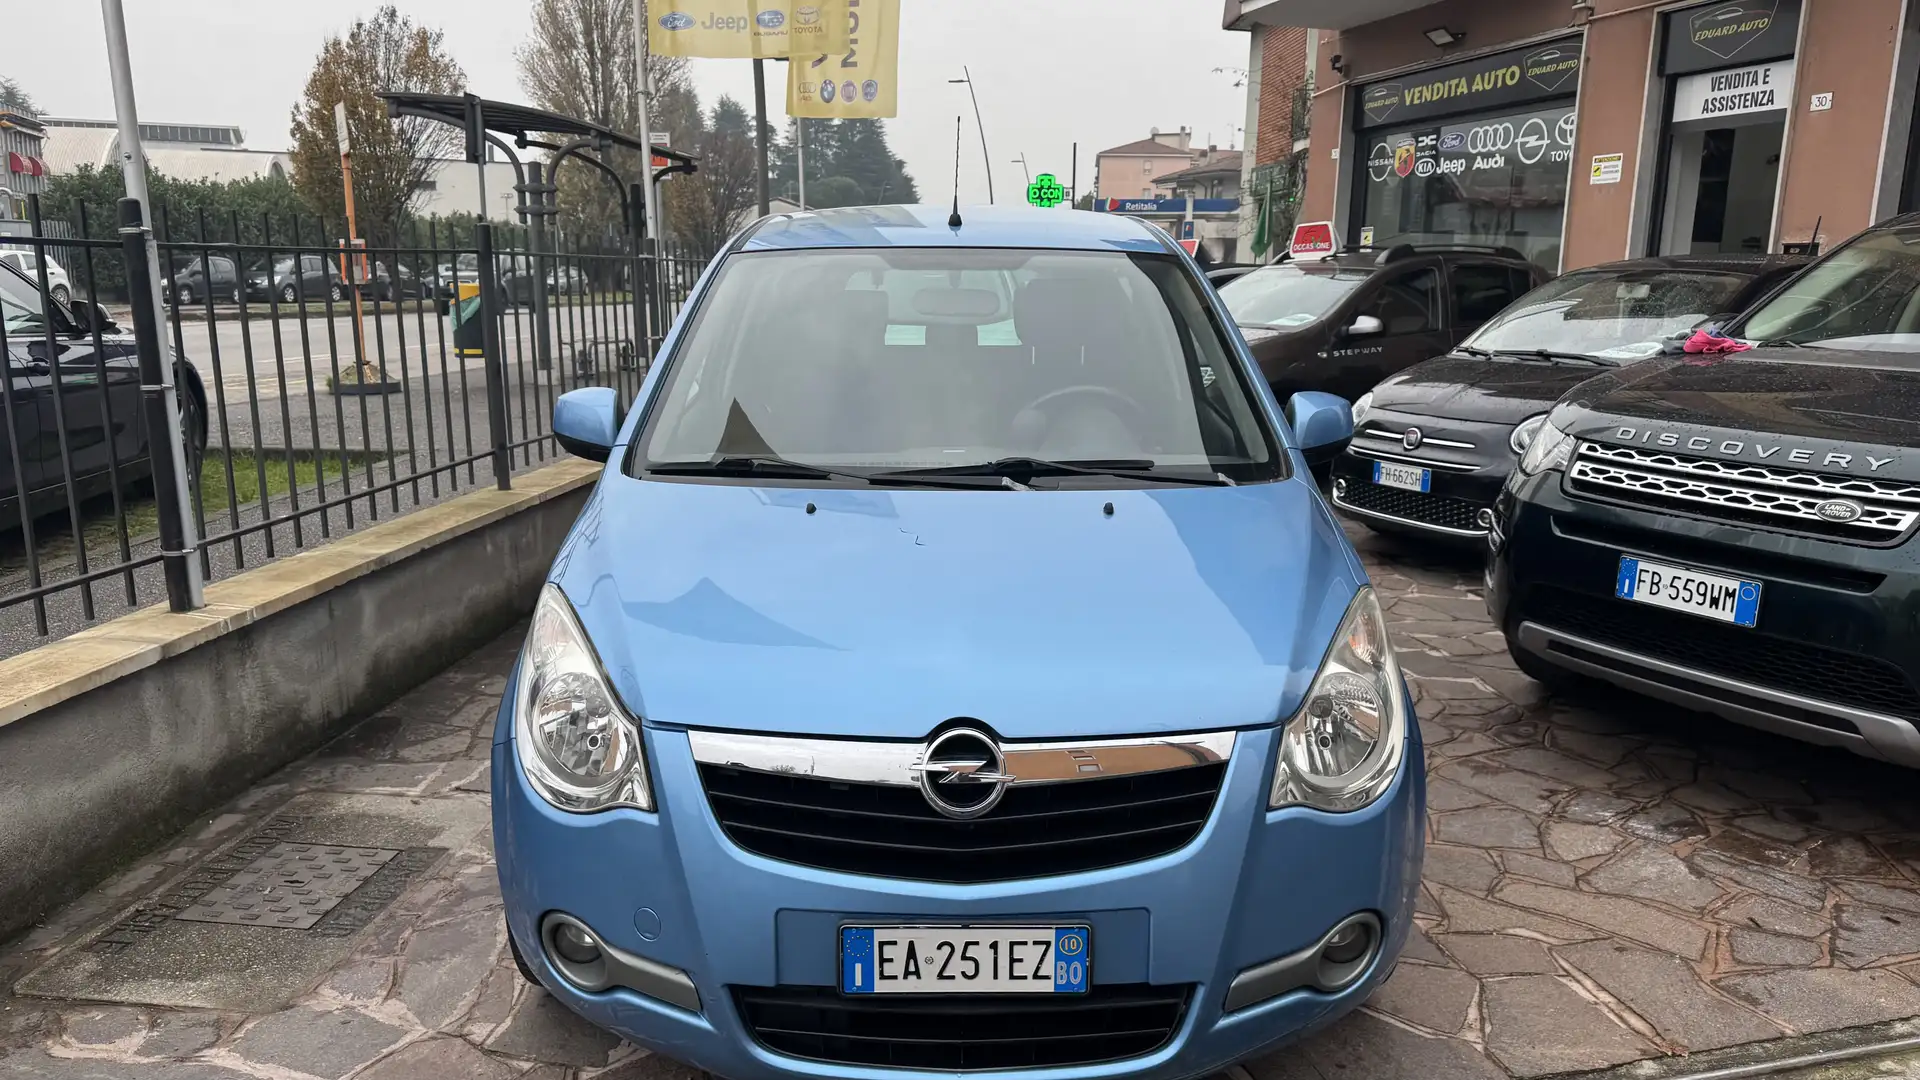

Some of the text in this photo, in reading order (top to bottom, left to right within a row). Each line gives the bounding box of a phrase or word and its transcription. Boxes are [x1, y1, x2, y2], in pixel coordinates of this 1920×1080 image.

[701, 12, 748, 33] Jeep
[793, 26, 823, 34] TOYOTA
[1694, 17, 1769, 42] EDUARD AUTO
[1527, 59, 1578, 76] EDUARD AUTO
[1404, 65, 1520, 106] VENDITA AUTO
[1711, 68, 1771, 92] VENDITA E
[1701, 89, 1775, 115] ASSISTENZA
[1815, 96, 1828, 107] 30
[1367, 157, 1394, 167] NISSAN
[1436, 157, 1466, 175] Jeep
[1472, 153, 1505, 170] Audi
[1125, 202, 1157, 211] Retitalia
[1333, 346, 1382, 357] STEPWAY
[1615, 427, 1894, 471] DISCOVERY
[1056, 961, 1083, 985] BO
